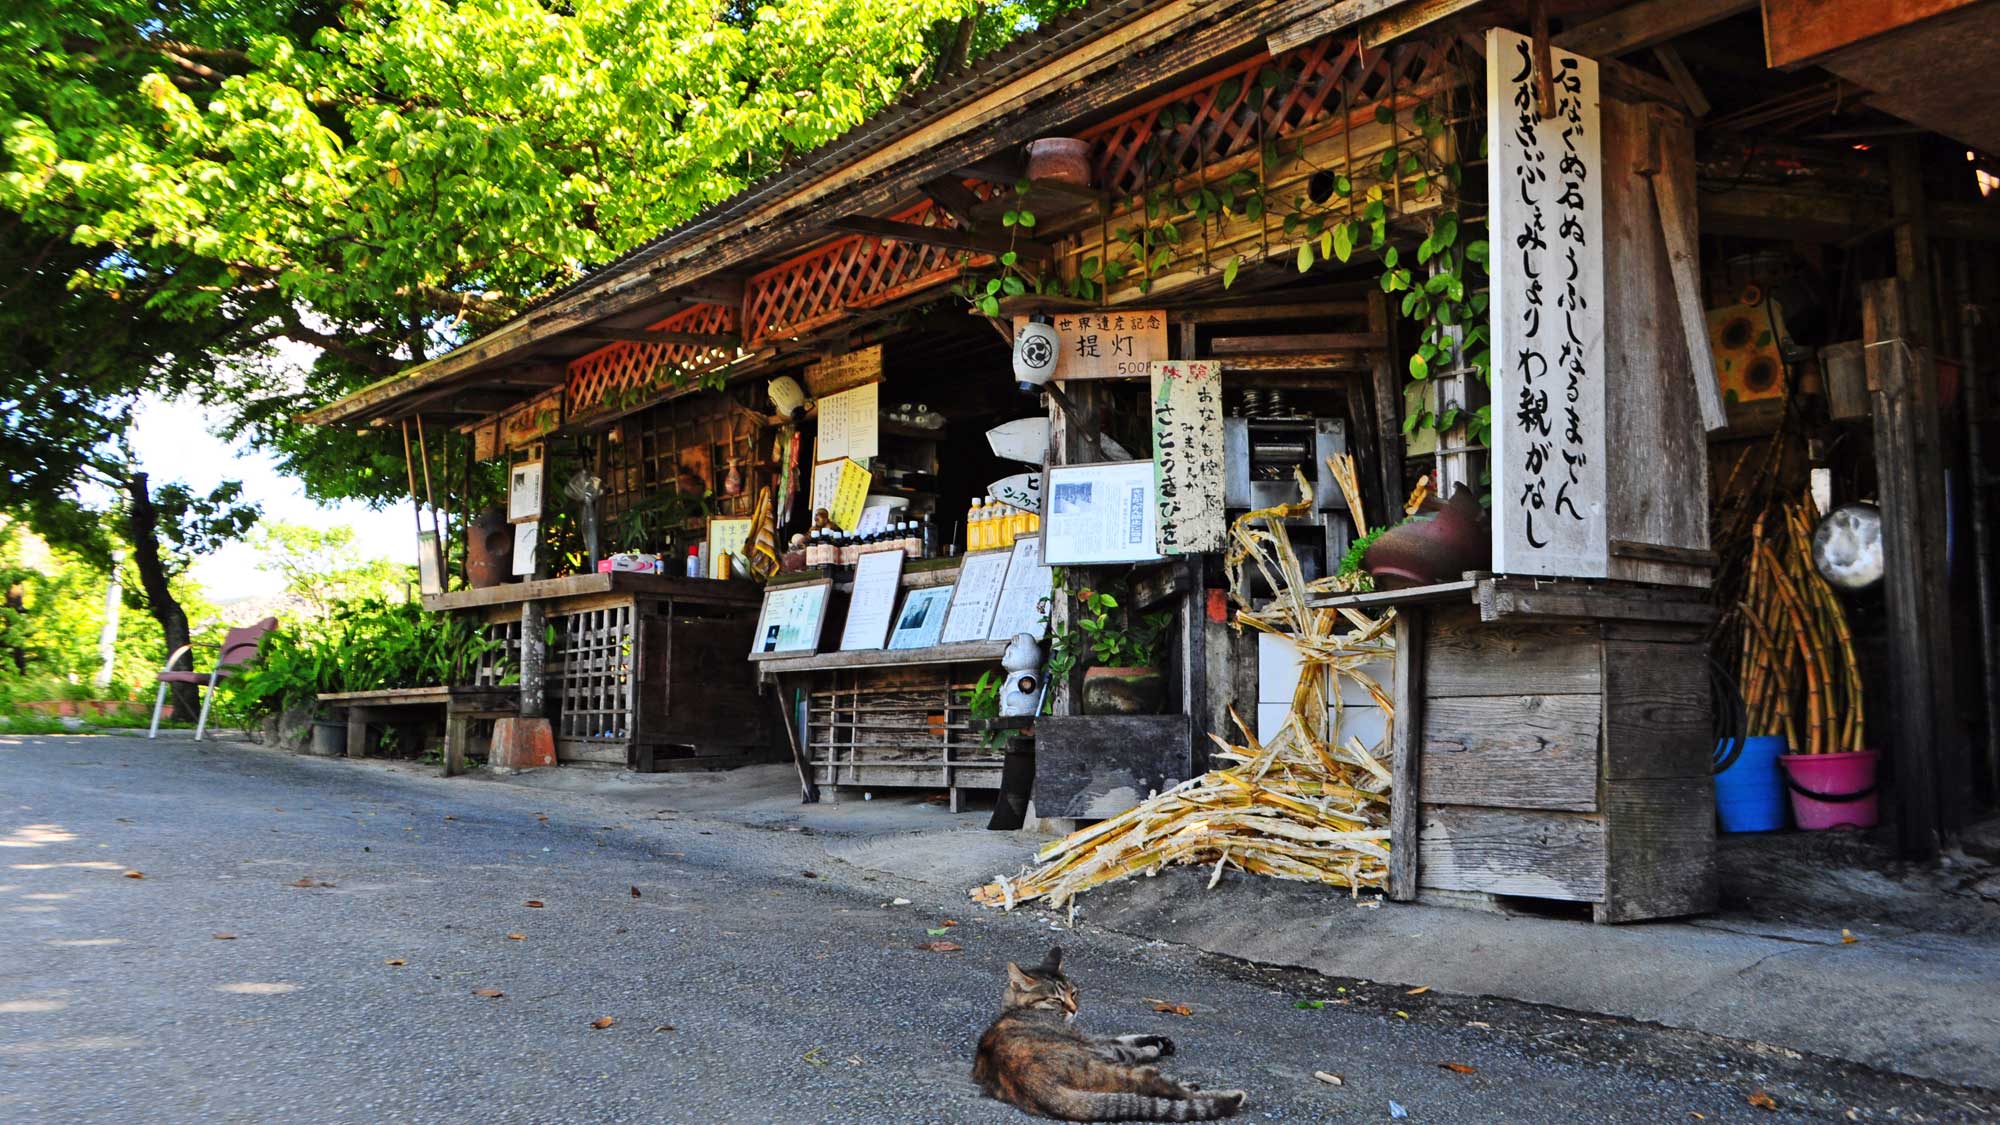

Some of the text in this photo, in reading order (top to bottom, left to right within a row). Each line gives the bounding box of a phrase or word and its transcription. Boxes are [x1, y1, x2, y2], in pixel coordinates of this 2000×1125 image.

[1058, 315, 1161, 332] 世界遺産記念
[1077, 334, 1134, 358] 提灯
[1155, 405, 1181, 546] さとうきびを
